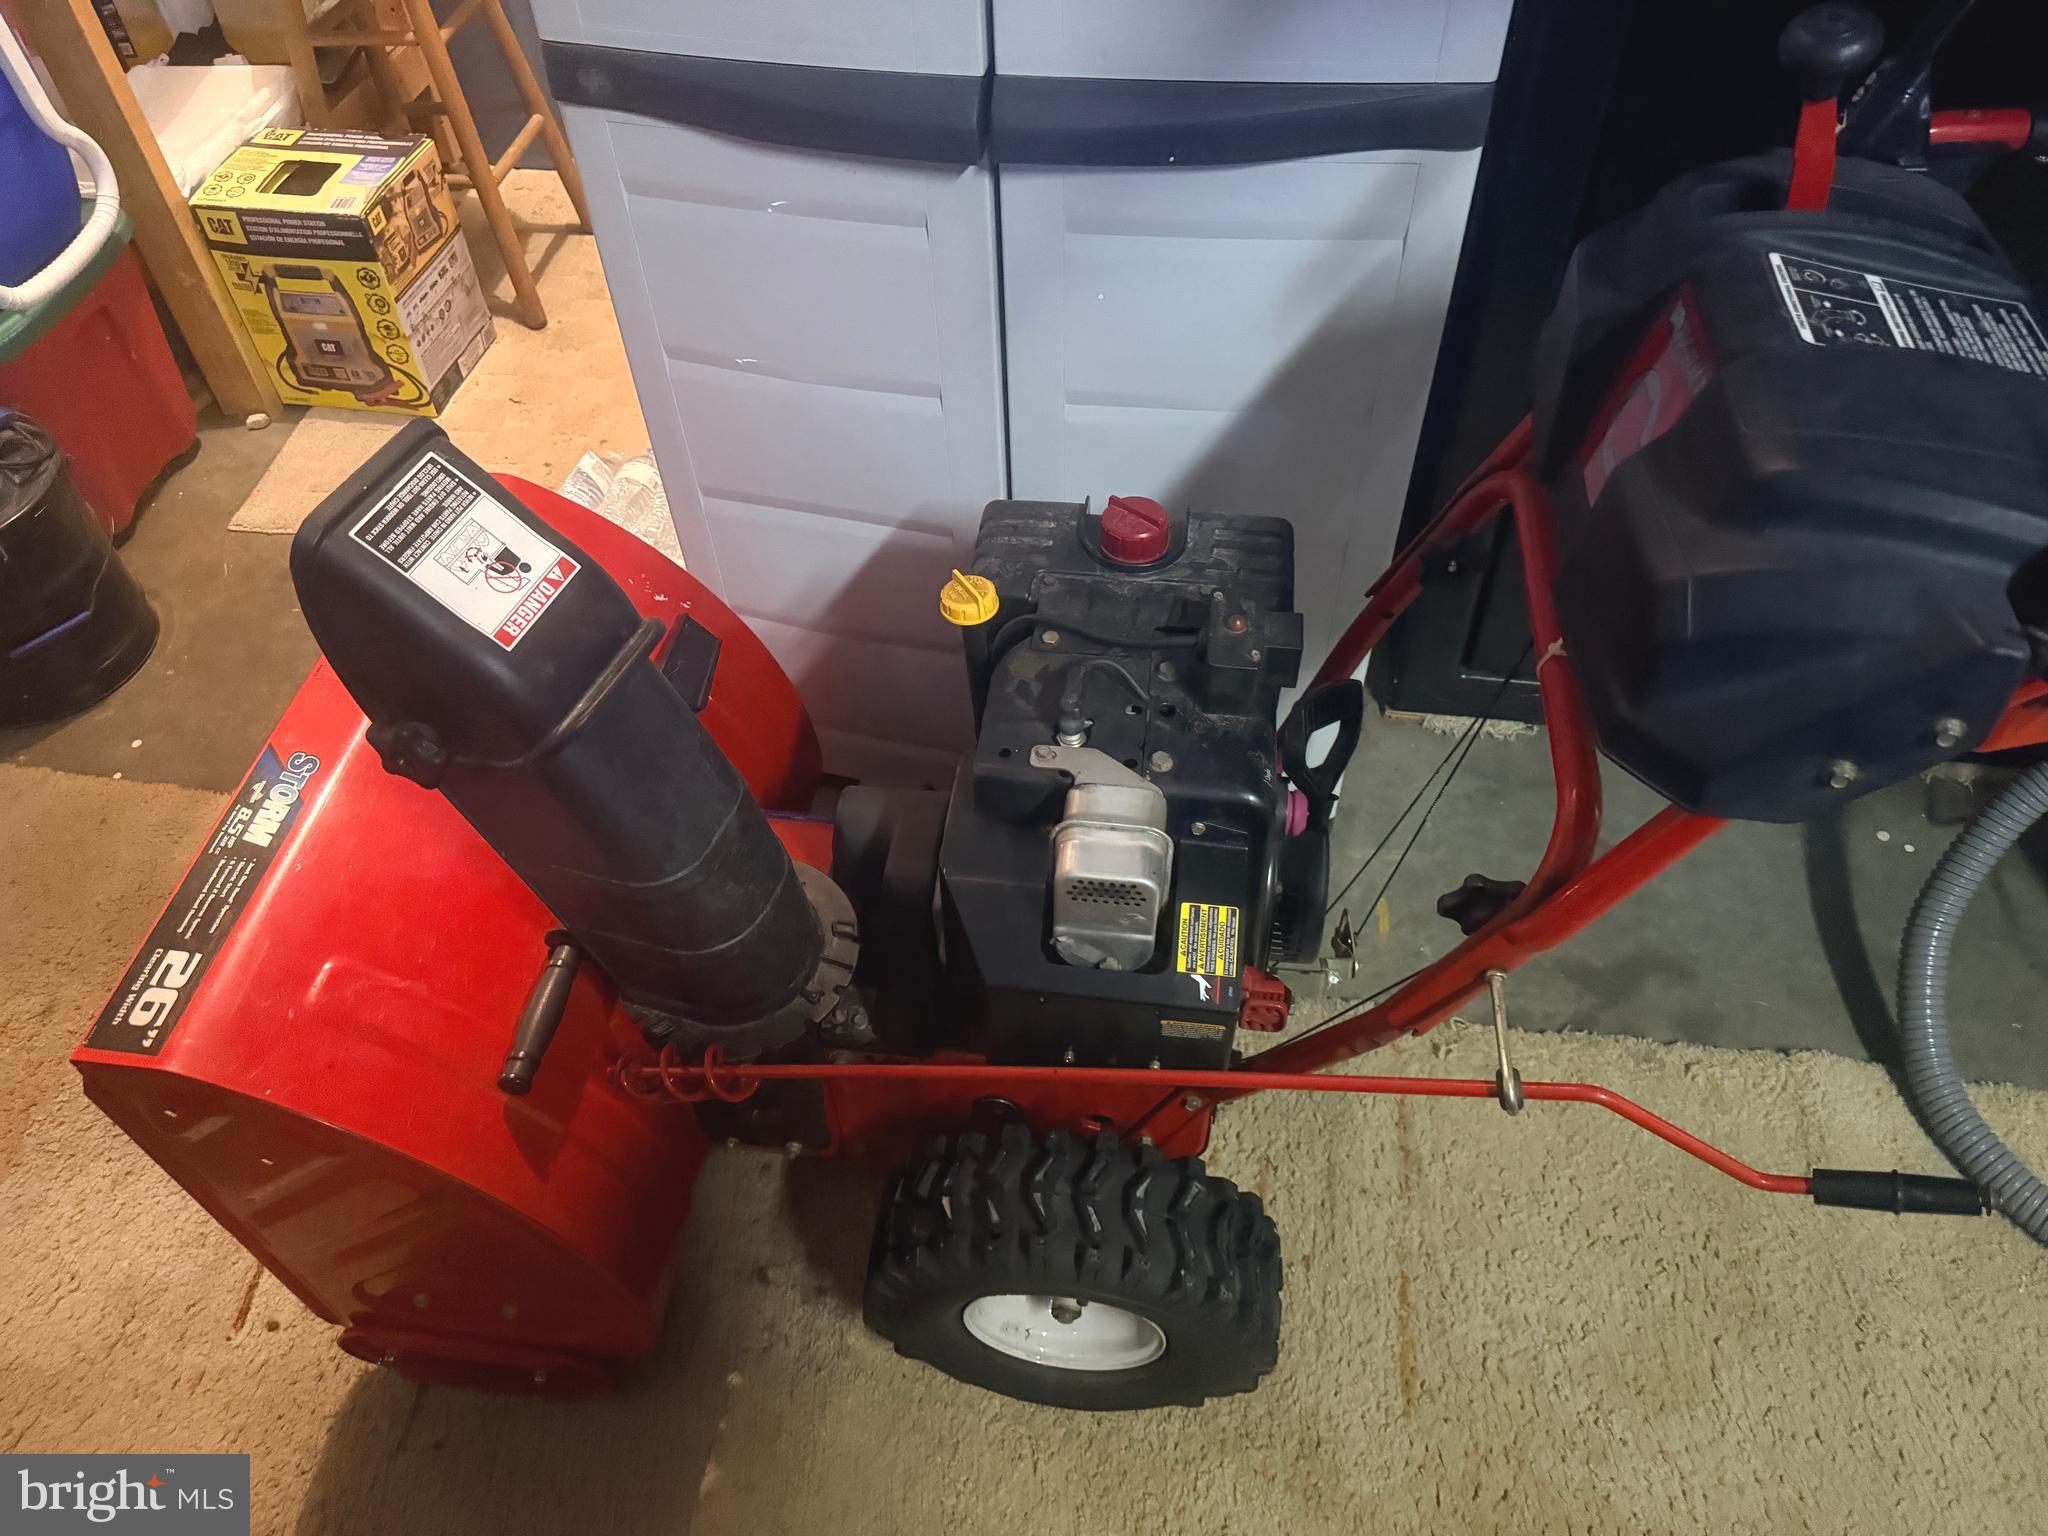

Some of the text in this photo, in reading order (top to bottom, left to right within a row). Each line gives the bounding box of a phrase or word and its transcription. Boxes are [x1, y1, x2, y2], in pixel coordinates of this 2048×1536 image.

[207, 217, 235, 236] CAT
[241, 216, 282, 224] PROFESSIONAL
[371, 211, 383, 228] CAT
[321, 342, 337, 352] CAT
[415, 462, 433, 479] UNCLOG
[428, 467, 438, 476] USE
[396, 477, 419, 499] DISCHARGE
[453, 485, 464, 495] AND
[396, 501, 404, 509] OR
[401, 492, 414, 503] TOOL
[378, 476, 451, 550] MOVING PARTS HAVE STOPPED BEFORE
[380, 507, 399, 524] WOODEN
[383, 480, 456, 554] SHUT OFF ENGINE AND WAIT UNTIL ALL
[444, 512, 457, 524] HAND
[453, 504, 464, 514] PUT
[370, 522, 384, 534] STICK
[396, 489, 469, 564] ROTATING PARTS CAN AMPUTATE FINGERS
[412, 539, 431, 557] CONTACT
[402, 556, 415, 568] WITH
[501, 580, 556, 637] DANGER
[242, 752, 320, 848] STORM
[225, 807, 254, 848] 8.5 HP
[215, 865, 232, 888] Forward
[244, 862, 254, 874] Just
[219, 861, 245, 898] Electric Start
[237, 875, 247, 886] One
[192, 893, 205, 908] Steel
[197, 894, 215, 917] Reverse
[208, 904, 230, 934] Operation
[1180, 918, 1188, 949] CAUTION
[1198, 908, 1207, 961] AVERTISSMENT
[1217, 921, 1225, 953] CUIDADO
[111, 948, 164, 1025] Clearing Width
